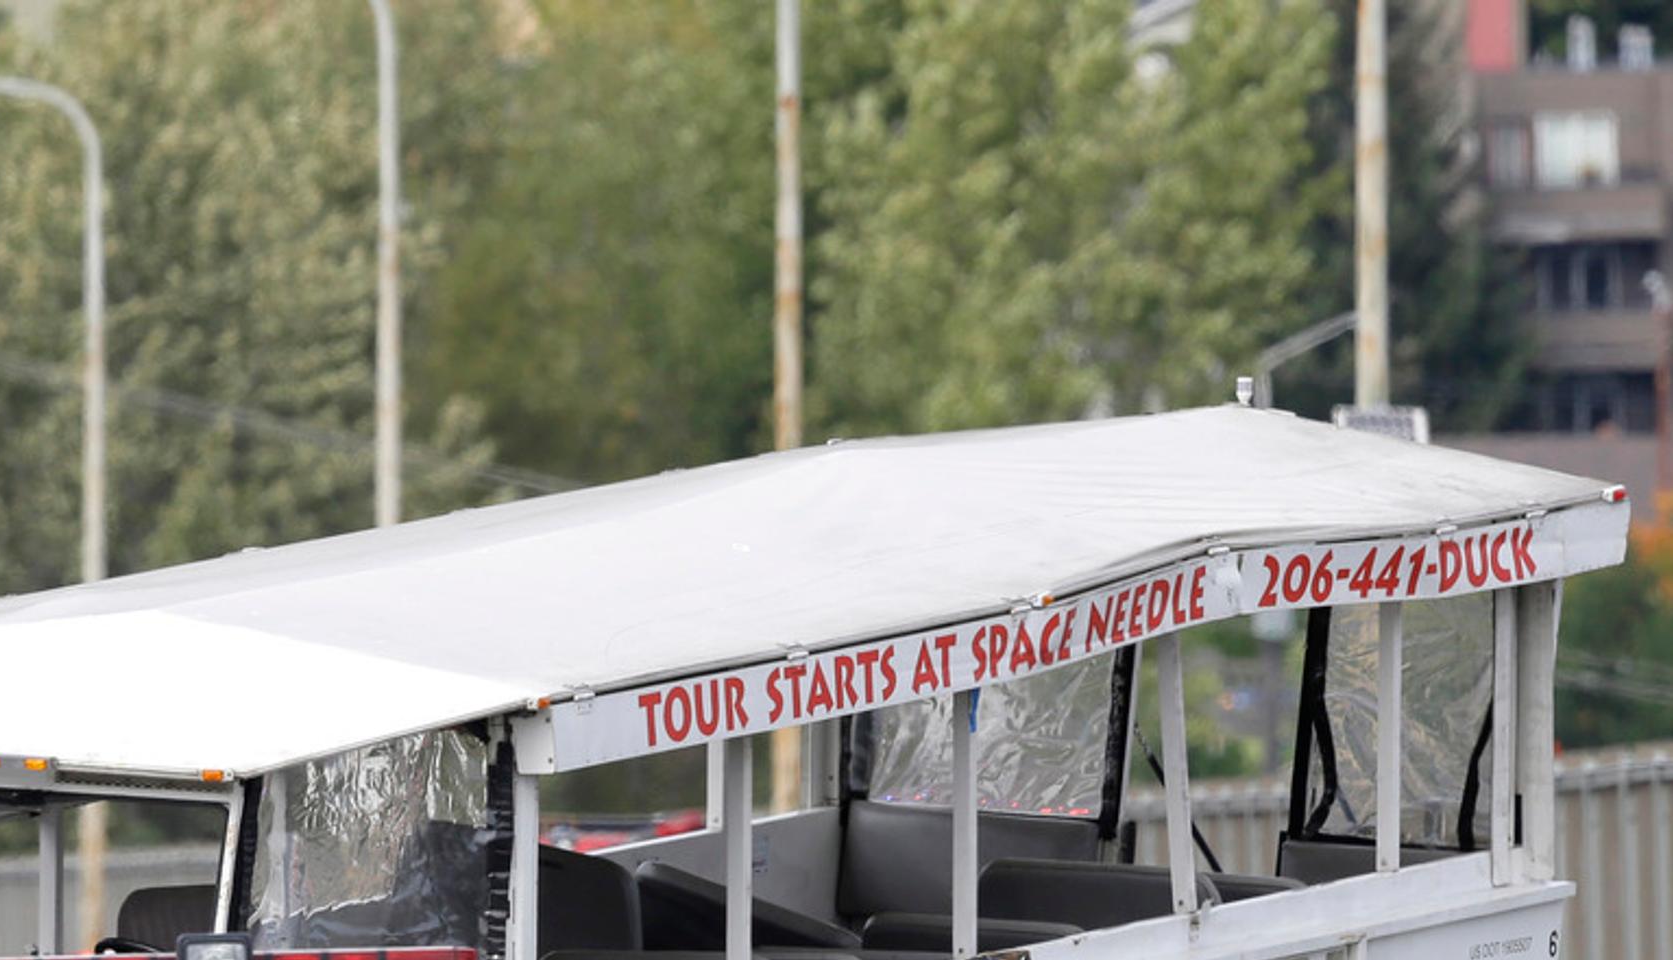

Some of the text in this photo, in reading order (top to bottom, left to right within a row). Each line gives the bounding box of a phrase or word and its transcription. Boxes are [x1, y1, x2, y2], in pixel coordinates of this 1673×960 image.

[1257, 527, 1537, 608] 206-441-DUCK
[638, 565, 1206, 747] TOUR STARTS AT SPACE NEEDLE
[1548, 929, 1559, 957] 6
